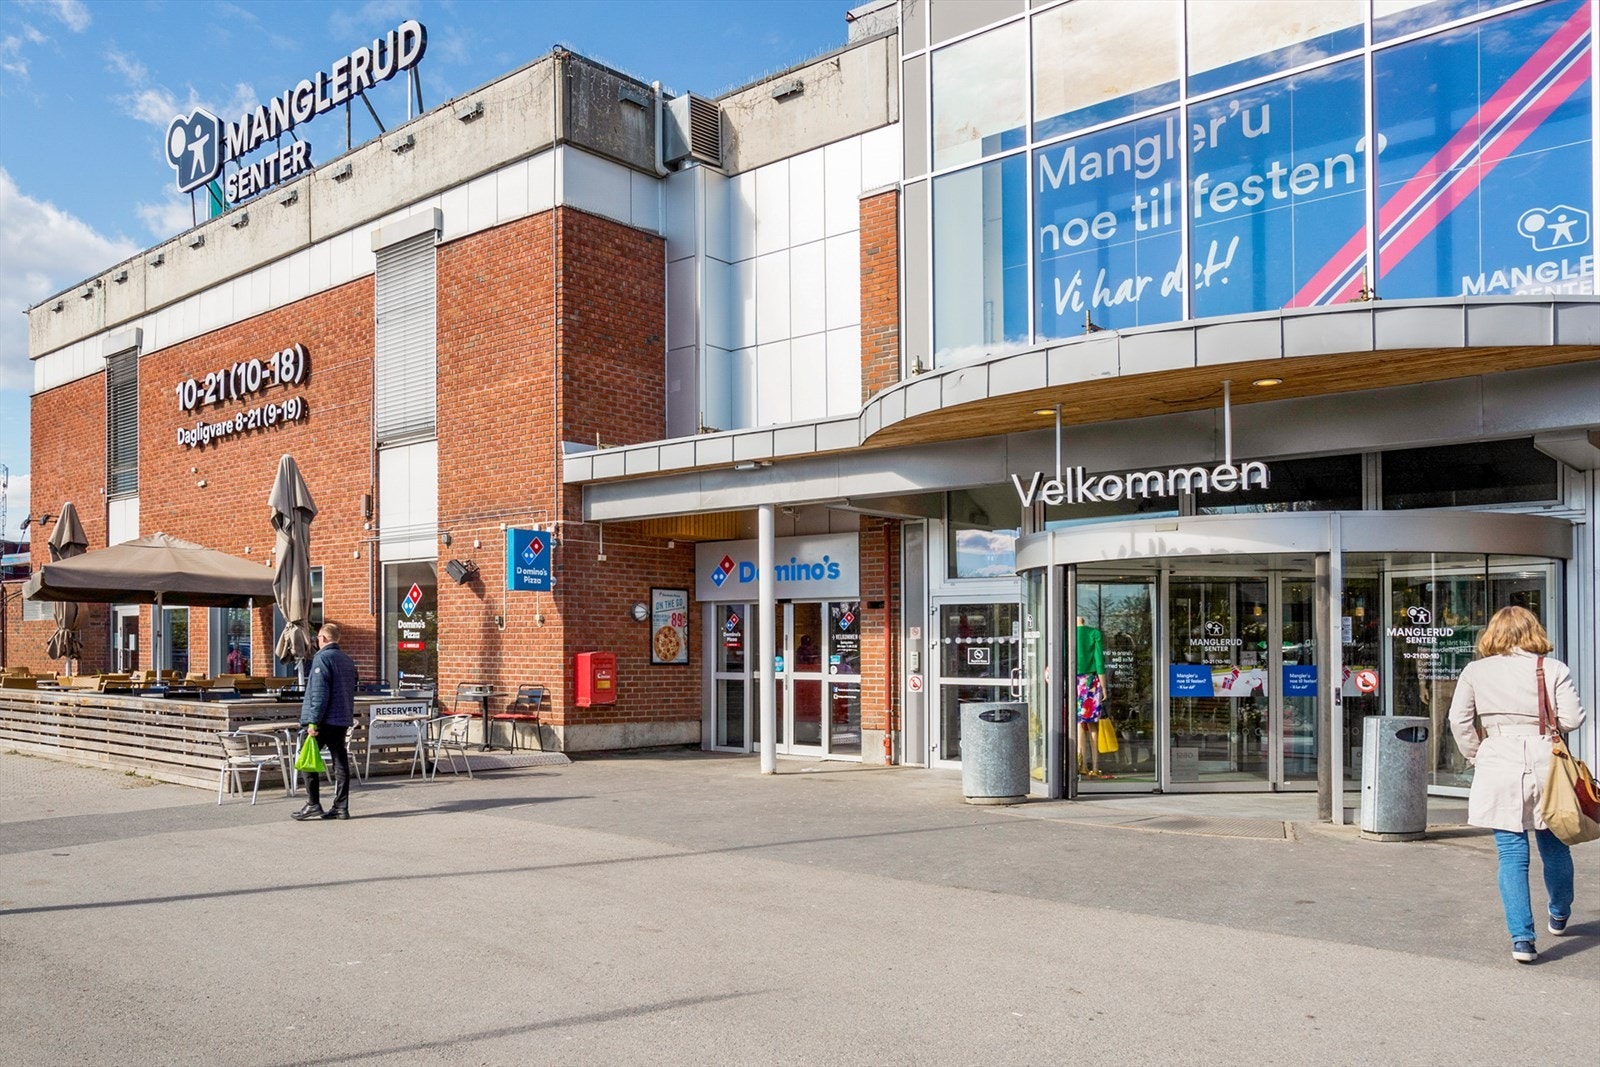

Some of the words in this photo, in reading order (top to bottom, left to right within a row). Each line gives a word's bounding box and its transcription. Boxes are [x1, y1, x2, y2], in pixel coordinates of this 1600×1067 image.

[224, 19, 424, 163] MANGLERUD
[226, 140, 308, 203] SENTER
[1040, 210, 1117, 253] noe
[1131, 182, 1172, 232] til
[1054, 268, 1084, 316] Vi
[1092, 268, 1153, 310] har
[175, 368, 226, 411] 10-21
[229, 342, 305, 401] (10-18)
[177, 420, 234, 448] Dagligvare
[235, 407, 261, 432] 8-21
[263, 396, 301, 427] (9-19)
[1011, 460, 1269, 508] Velkommen
[516, 566, 548, 576] Domino's
[738, 554, 841, 584] Dmino's
[523, 575, 542, 585] Pizza
[398, 619, 426, 629] Domino's
[403, 629, 420, 639] Pizza
[1386, 627, 1455, 637] MANGLERUD
[1189, 638, 1243, 647] MANGLERUD
[1405, 636, 1437, 644] SENTER
[1403, 652, 1419, 660] 10-21
